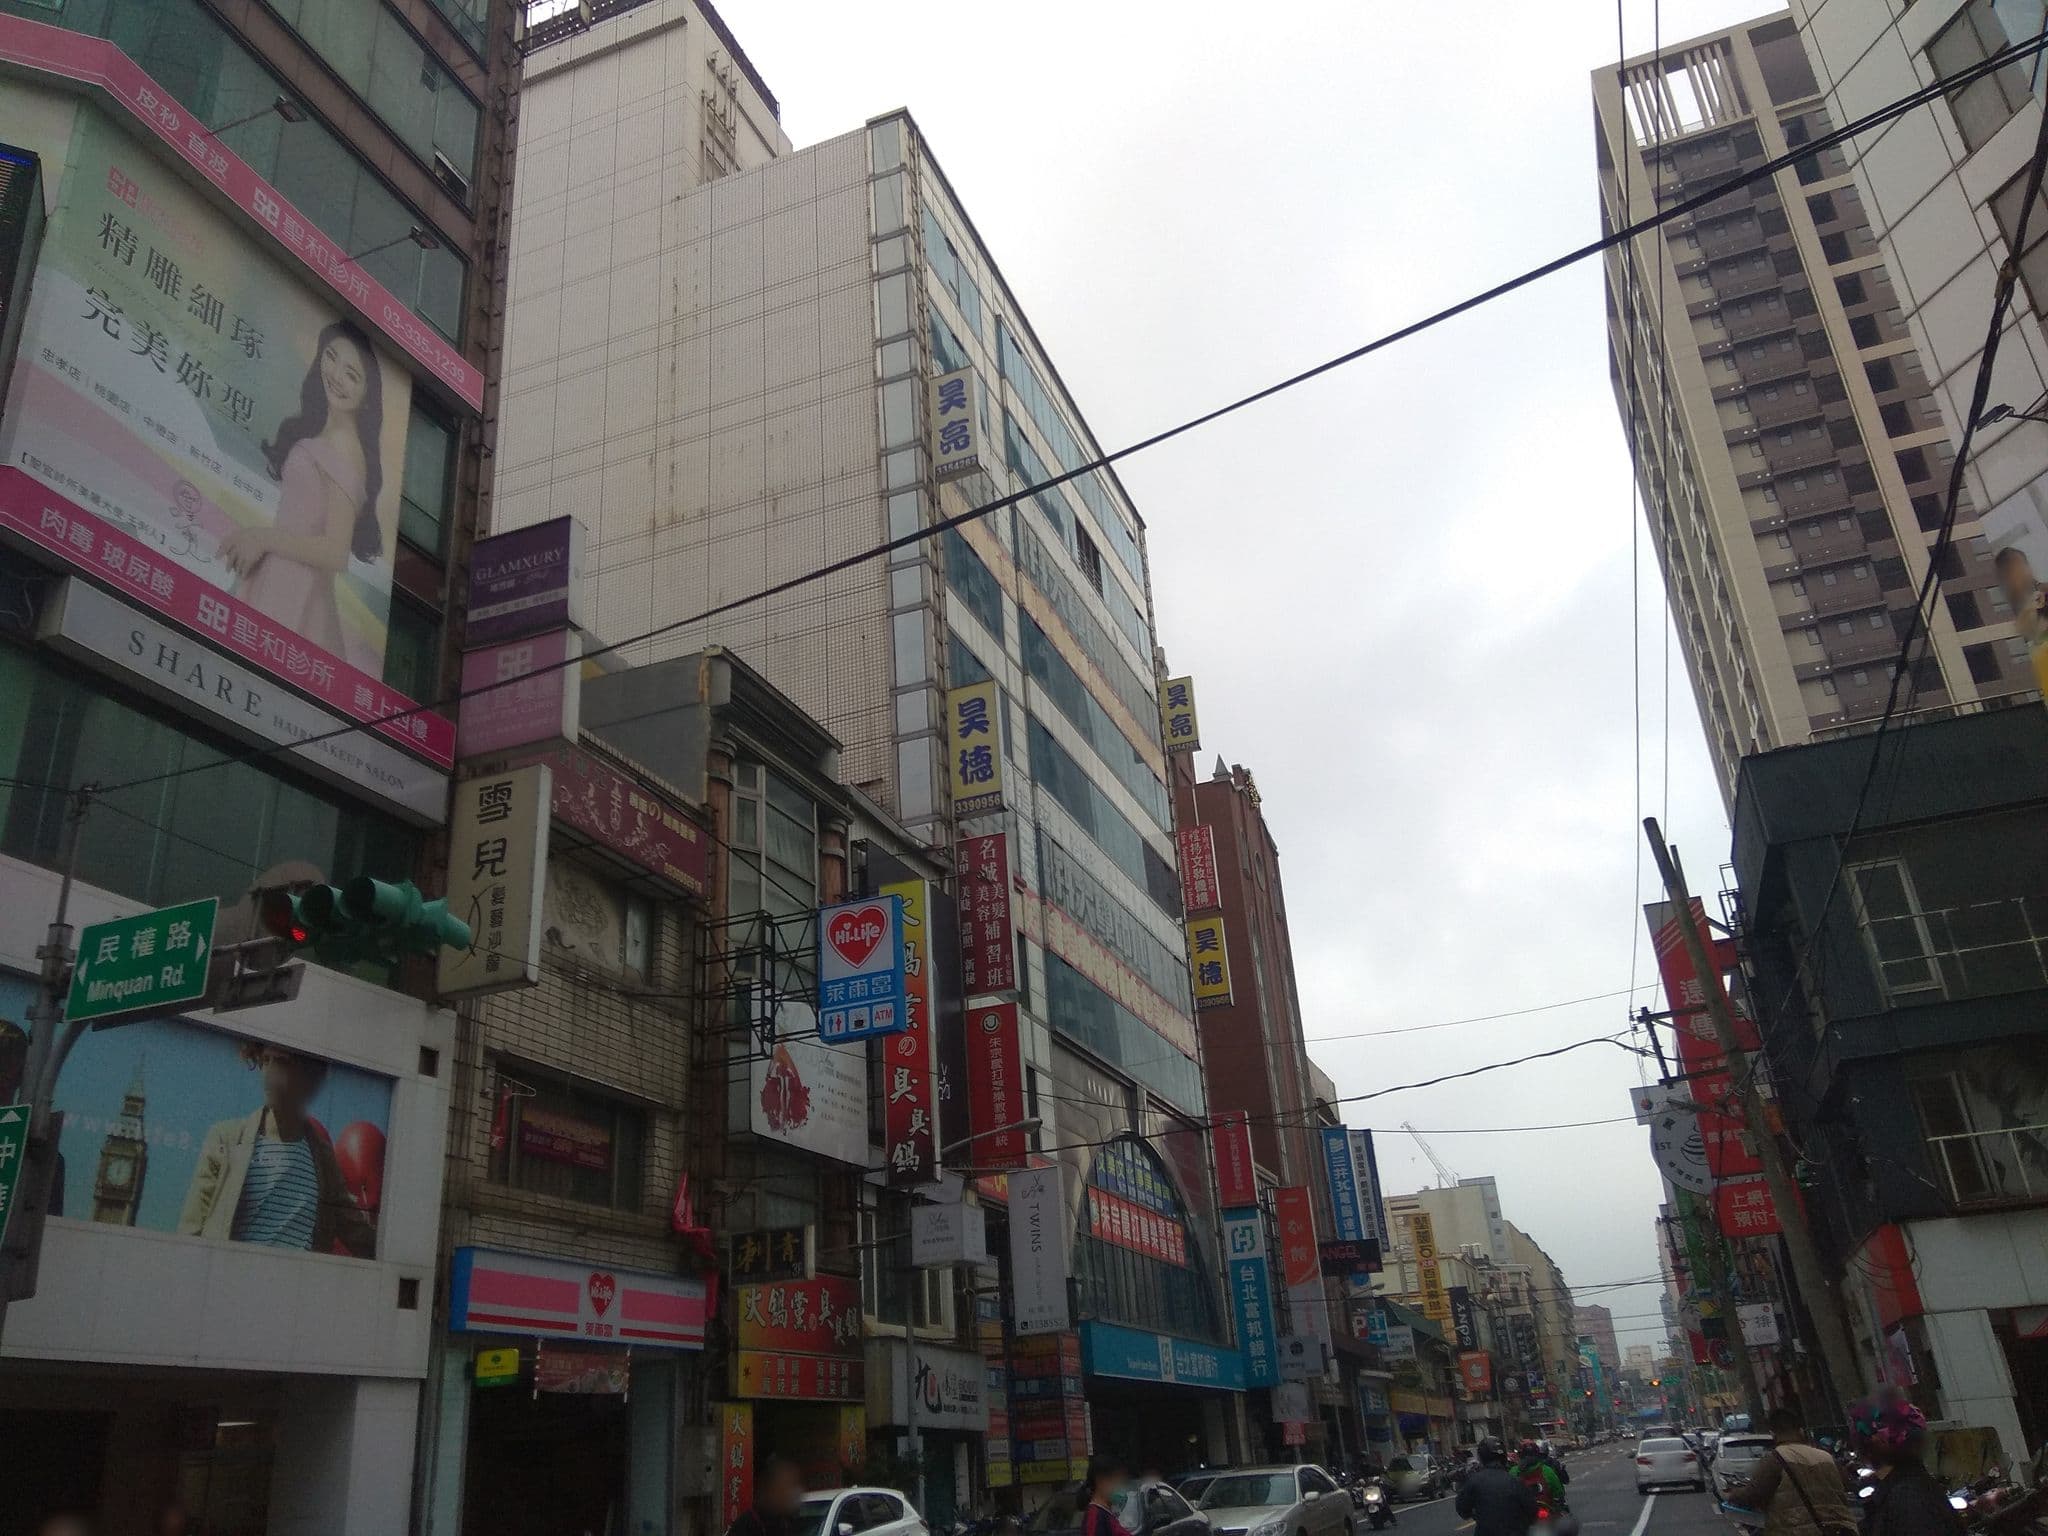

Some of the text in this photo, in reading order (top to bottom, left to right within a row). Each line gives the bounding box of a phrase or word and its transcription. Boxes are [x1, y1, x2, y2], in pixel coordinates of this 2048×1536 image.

[283, 214, 369, 304] 聖和診所
[383, 304, 466, 384] 03-335-1239
[40, 506, 95, 553] 肉毒
[101, 540, 176, 600] 玻尿酸
[231, 611, 335, 693] 聖和診所
[128, 630, 265, 718] SHARE
[955, 793, 1000, 814] 3390956
[472, 781, 513, 880] 雪兒
[94, 920, 192, 966] 民權路
[86, 963, 187, 1005] Minquan Rd.
[874, 1008, 892, 1021] ATM
[1732, 1188, 1773, 1208] 上網
[1029, 1202, 1042, 1254] TWINS
[1239, 1263, 1269, 1378] 台北富邦銀行
